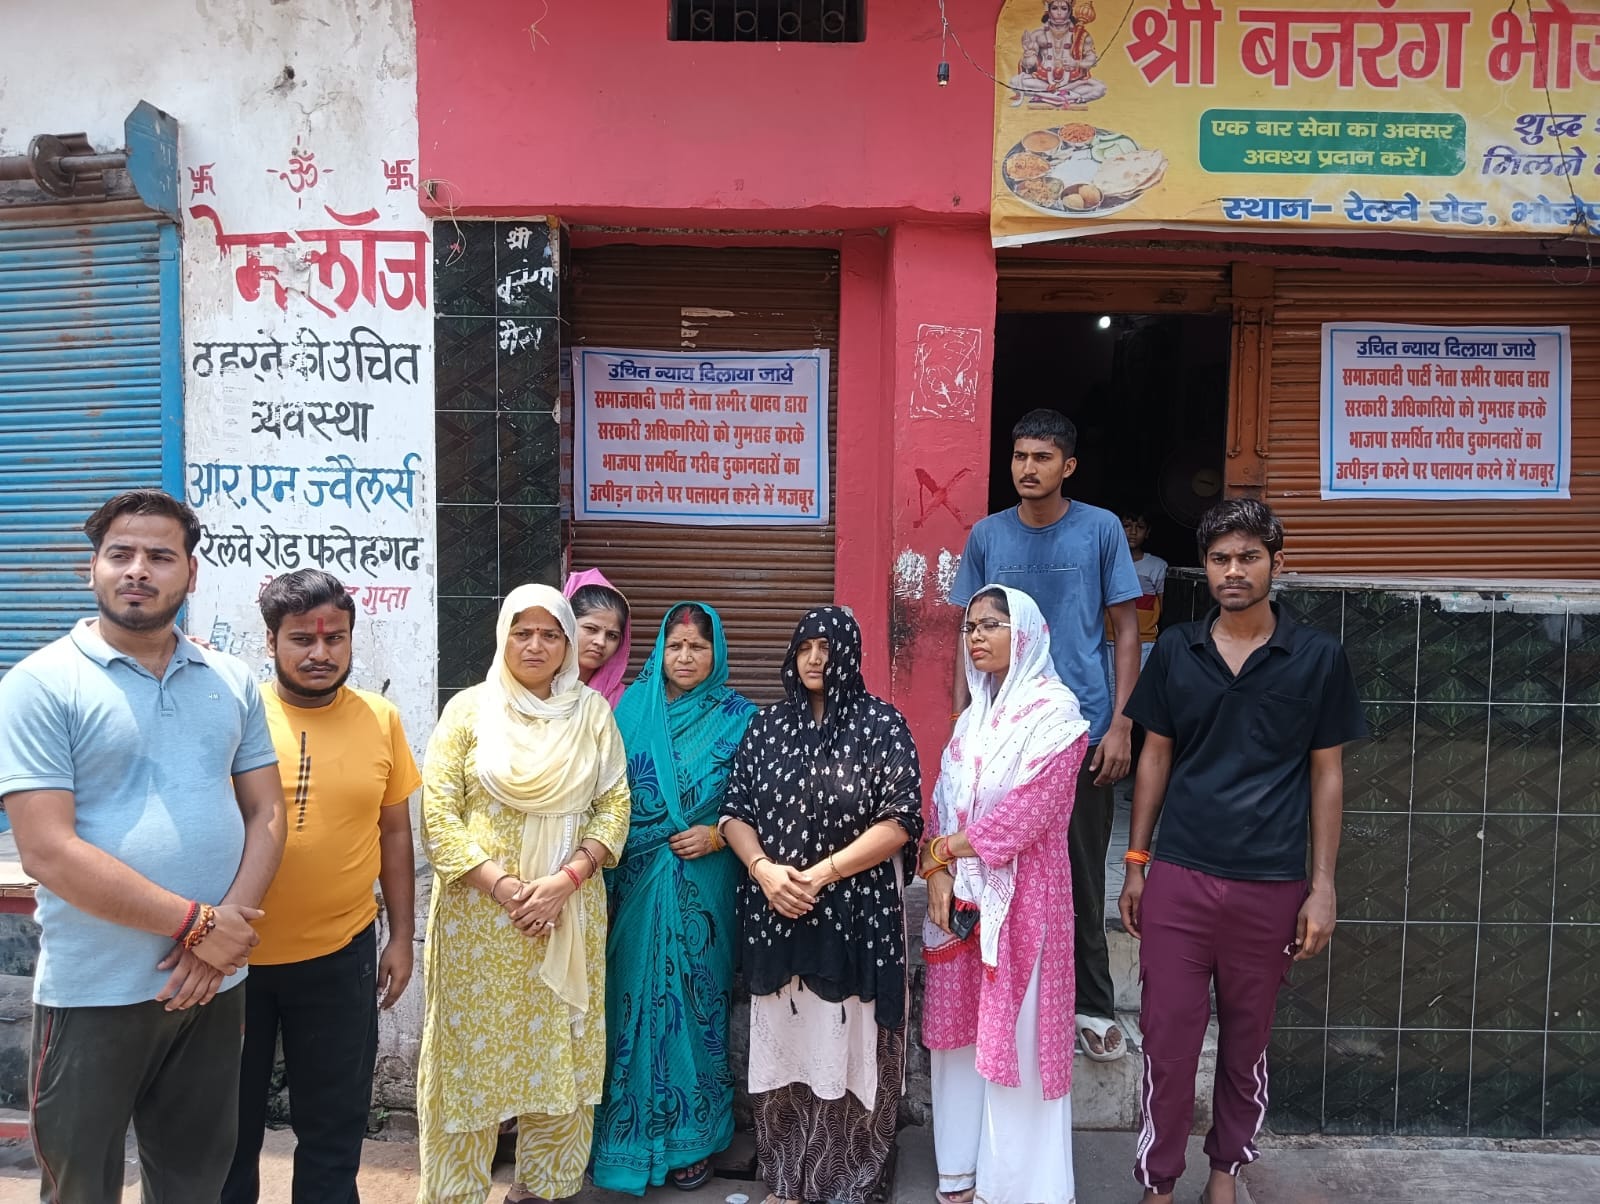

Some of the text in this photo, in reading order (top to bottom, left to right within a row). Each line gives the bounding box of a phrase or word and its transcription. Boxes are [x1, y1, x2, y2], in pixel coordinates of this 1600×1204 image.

[1126, 0, 1222, 84] श्री
[1239, 0, 1471, 88] बजरंग
[1211, 117, 1454, 139] एक बार सेवा का अवसर
[1513, 114, 1587, 145] शुद्ध
[1244, 150, 1312, 164] अवश्य
[1318, 150, 1374, 168] प्रदान
[1482, 145, 1587, 176] मिलने
[327, 326, 422, 384] उचित
[1356, 335, 1536, 357] उचित न्याय दिलाया जाये
[608, 360, 794, 382] उचित न्याय दिलाया जाये
[1343, 364, 1550, 388] समाजवादी पार्टी नेता समीर यादव द्वारा
[594, 387, 808, 414] समाजवादी पार्टी नेता समीर यादव द्वारा
[1345, 395, 1546, 424] सरकारी अधिकारियो को गुमराह करके
[598, 418, 804, 449] सरकारी अधिकारियो को गुमराह करके
[1349, 426, 1542, 455] भाजपा समर्थित गरीब दुकानदारों का
[602, 450, 800, 480] भाजपा समर्थित गरीब दुकानदारों का
[1336, 457, 1555, 487] उत्पीड़न करने पर पलायन करने में मजबूर
[303, 452, 421, 513] ज्वैलर्स
[590, 481, 814, 513] उत्पीड़न करने पर पलायन करने में मजबूर
[200, 525, 253, 567] रेलवे
[256, 525, 302, 569] रोड
[362, 586, 412, 615] गुप्ता
